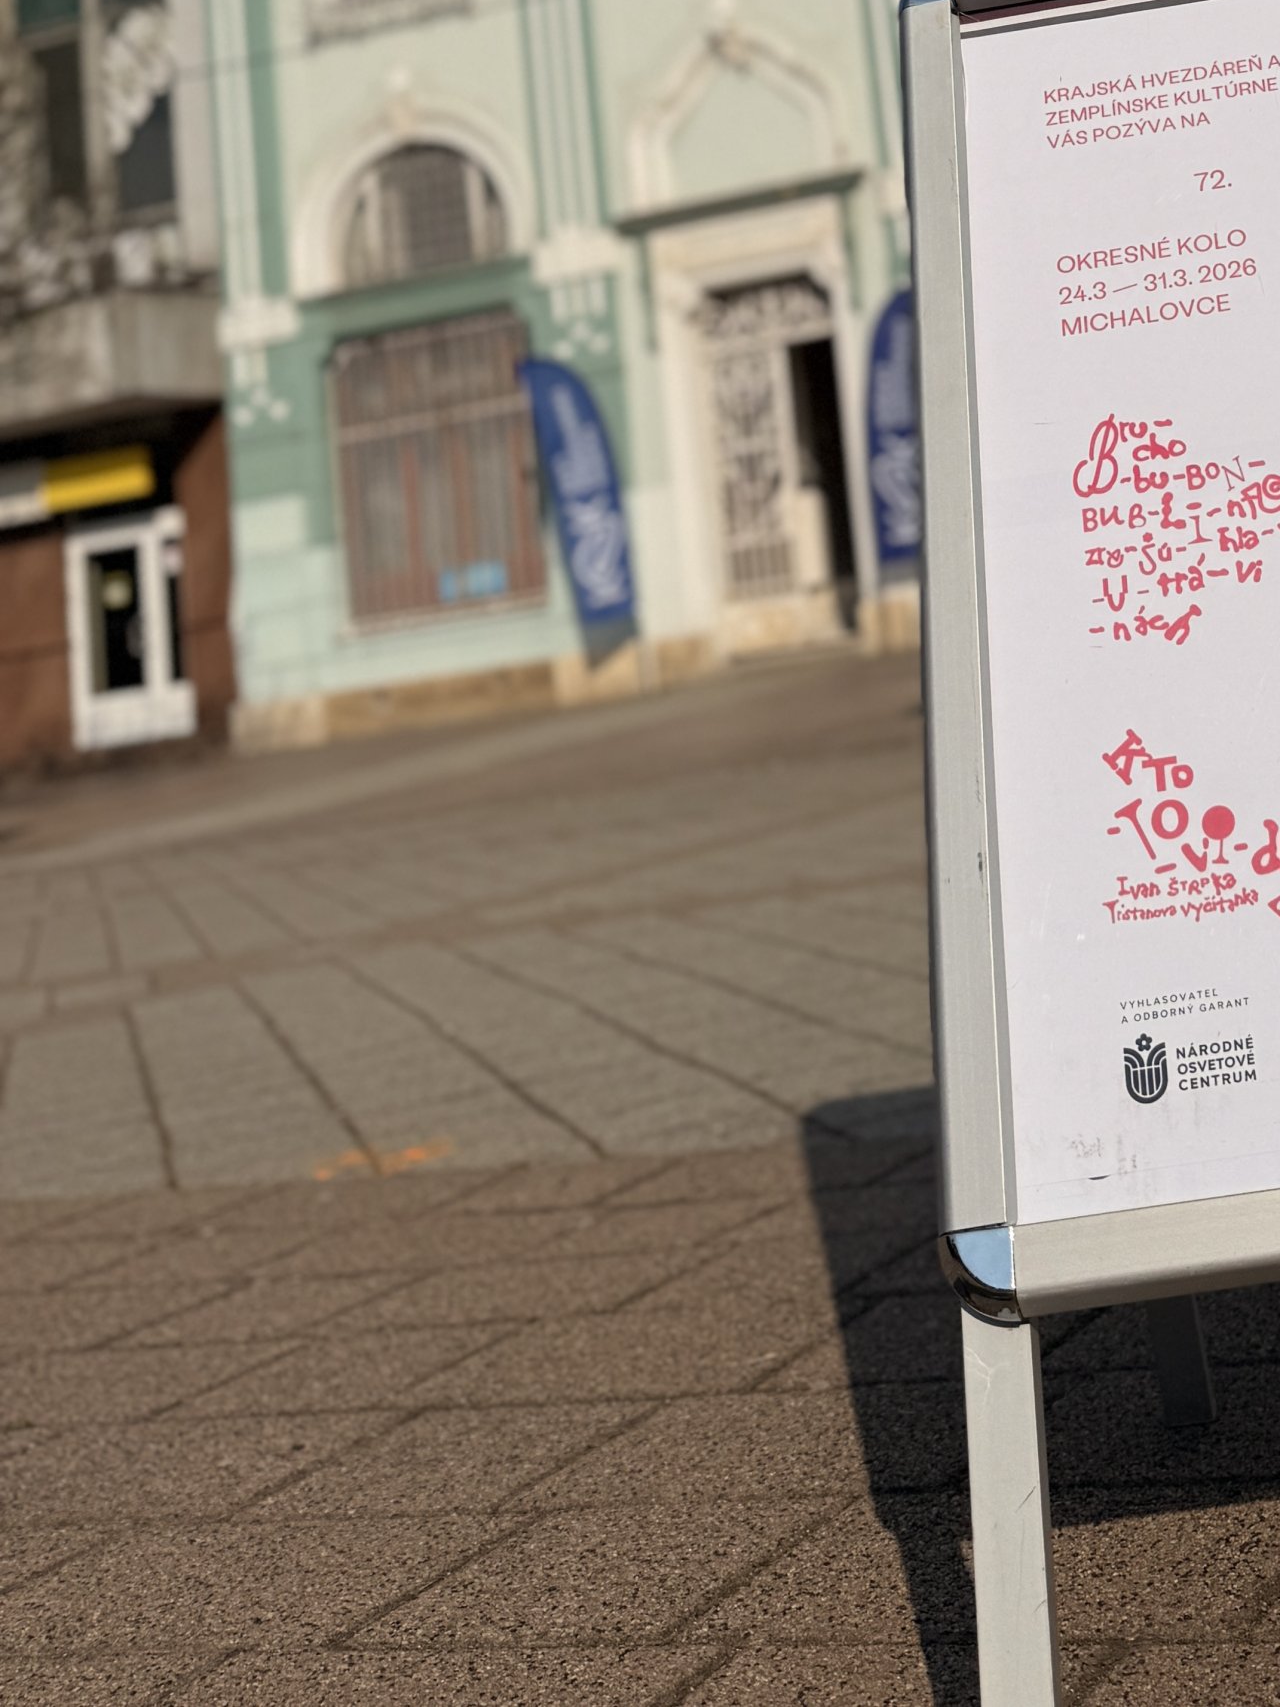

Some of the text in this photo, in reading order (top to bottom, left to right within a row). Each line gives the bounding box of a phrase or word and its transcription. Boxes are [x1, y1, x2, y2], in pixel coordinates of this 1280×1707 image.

[1044, 75, 1137, 104] KRAJSKÁ
[1141, 54, 1263, 89] HVEZDÁREŇ
[1046, 94, 1170, 126] ZEMPLÍNSKE
[1174, 76, 1279, 107] KULTÚRNE
[1047, 111, 1211, 149] VÁS POZÝVA NA
[1194, 169, 1232, 192] 72.
[1057, 229, 1247, 274] OKRESNÉ KOLO
[1059, 281, 1107, 305] 24.3
[1143, 269, 1193, 292] 31.3.
[1198, 258, 1257, 284] 2026
[1061, 293, 1231, 337] MICHALOVCE
[1116, 876, 1161, 900] Ivan
[1102, 899, 1177, 924] Tristanova
[1119, 988, 1219, 1010] VYHLASOVATEĽ
[1121, 996, 1250, 1024] A ODBORNÝ GARANT
[1176, 1034, 1254, 1060] NÁRODNÉ
[1177, 1050, 1256, 1075] OSVETOVÉ
[1178, 1069, 1257, 1091] CENTRUM
